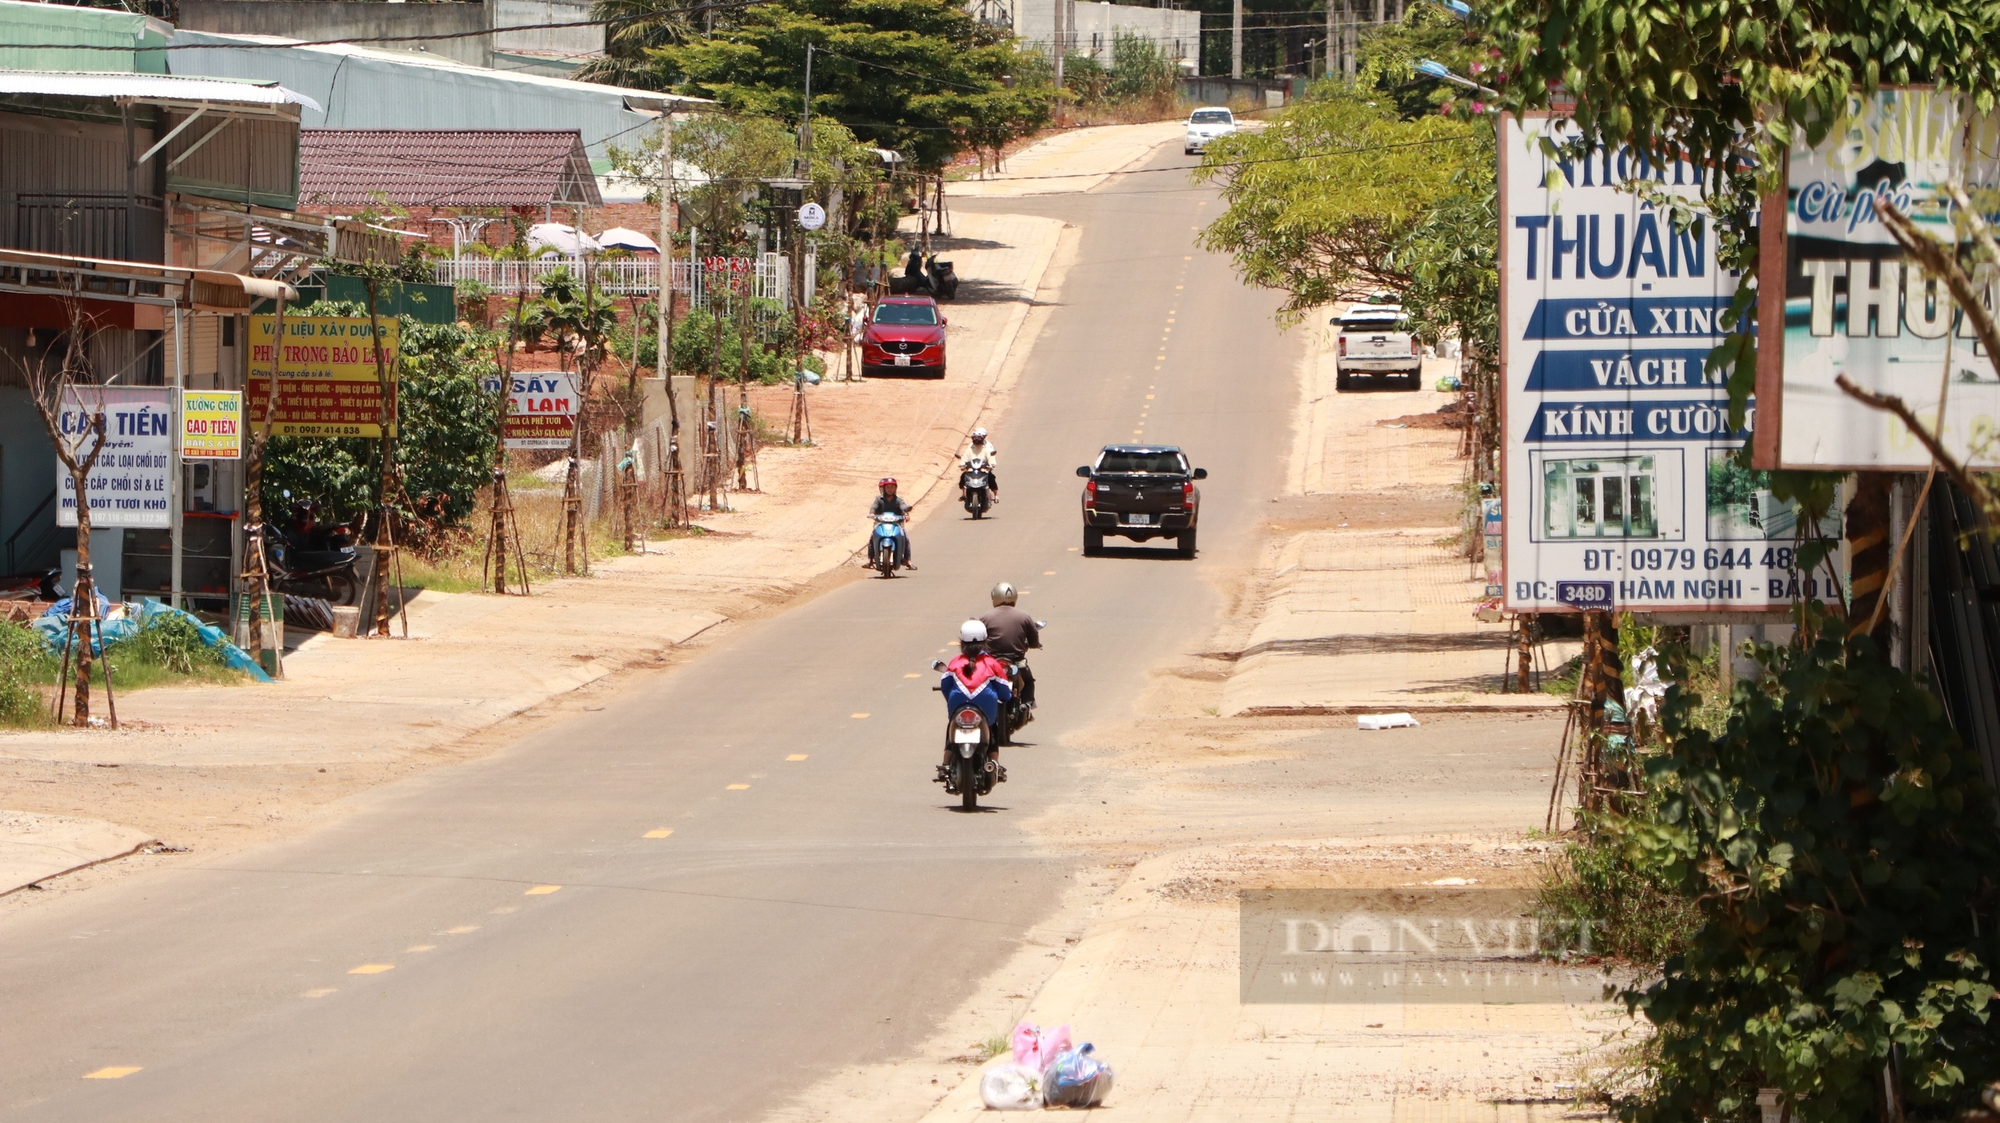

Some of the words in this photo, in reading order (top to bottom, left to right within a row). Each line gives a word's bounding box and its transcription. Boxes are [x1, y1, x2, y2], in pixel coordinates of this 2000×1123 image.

[1798, 181, 1846, 223] Cà
[1516, 200, 1705, 291] THUẬN
[1565, 302, 1638, 336] CỬA
[291, 321, 315, 339] LIỆU
[320, 321, 346, 336] XÂY
[252, 345, 274, 361] PH
[284, 346, 328, 367] TRỌNG
[332, 340, 358, 363] BẢO
[278, 371, 295, 379] cung
[1591, 354, 1687, 385] VÁCH
[511, 375, 558, 393] SẤY
[528, 398, 569, 412] LAN
[116, 405, 168, 436] TIẾN
[187, 419, 207, 434] CAO
[211, 415, 237, 434] TIẾN
[283, 426, 297, 434] ĐT:
[299, 426, 321, 434] 0987
[1544, 405, 1634, 436] KÍNH
[101, 452, 115, 467] CÁC
[118, 454, 134, 470] LOẠI
[154, 452, 167, 468] ĐÓT
[91, 473, 107, 490] CẤP
[145, 478, 151, 491] &
[115, 499, 140, 510] TƯƠI
[1584, 549, 1622, 572] ĐT:
[1631, 548, 1695, 571] 0979
[1704, 547, 1752, 571] 644
[1760, 547, 1800, 570] 48
[1516, 581, 1555, 600] ĐC:
[1620, 576, 1675, 600] HÀM
[1683, 579, 1742, 600] NGHI
[1565, 586, 1606, 602] 348D
